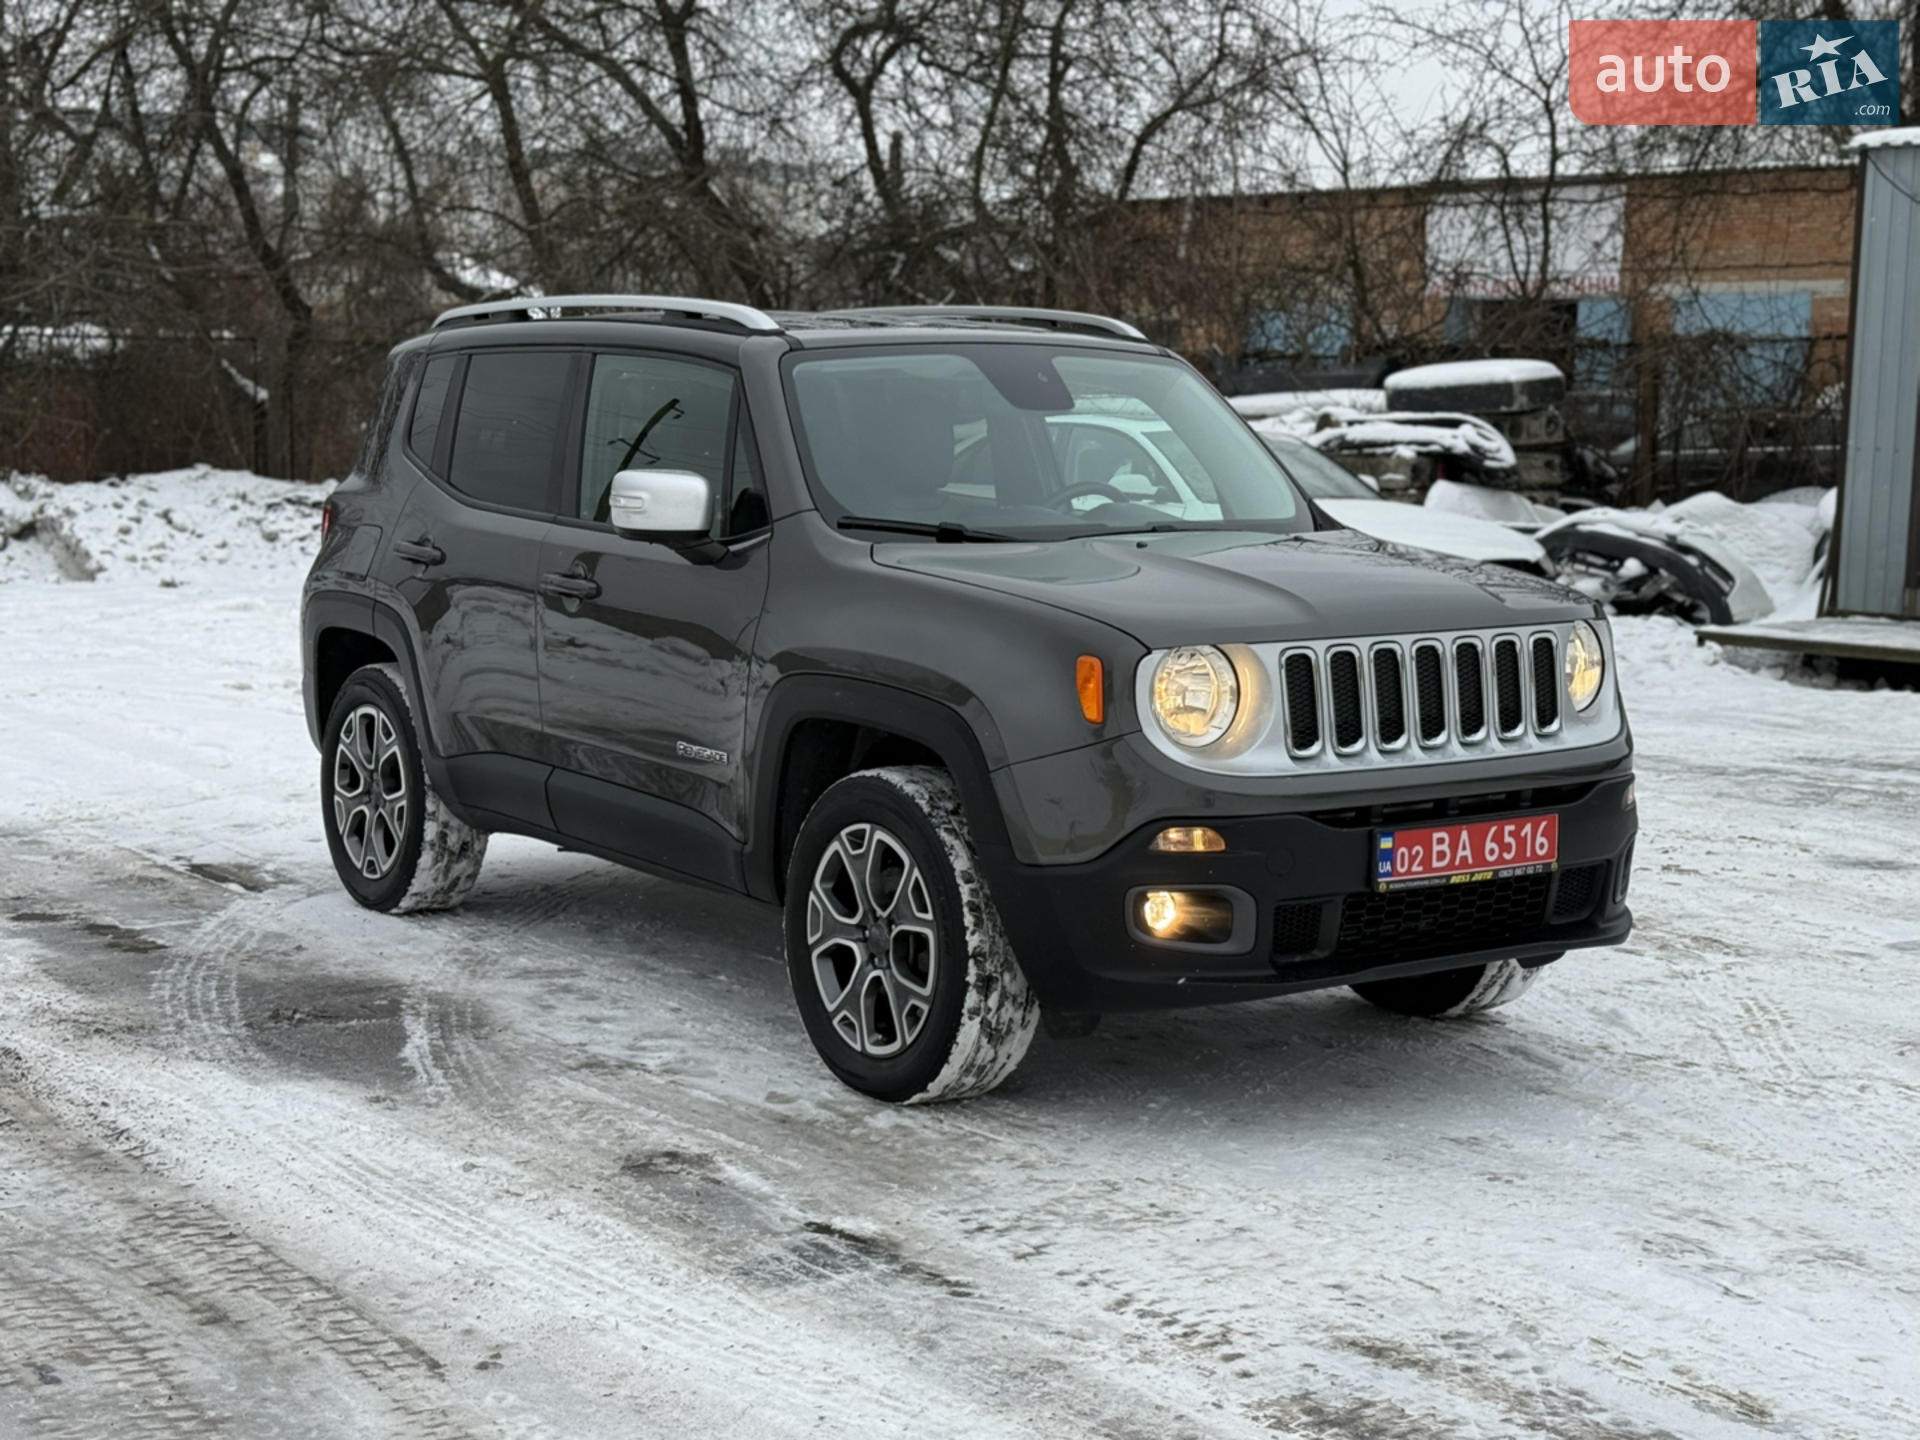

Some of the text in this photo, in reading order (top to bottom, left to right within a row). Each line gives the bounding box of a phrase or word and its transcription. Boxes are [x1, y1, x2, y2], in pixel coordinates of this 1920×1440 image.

[1396, 821, 1549, 873] 02 BA 6516
[1378, 860, 1392, 873] UA
